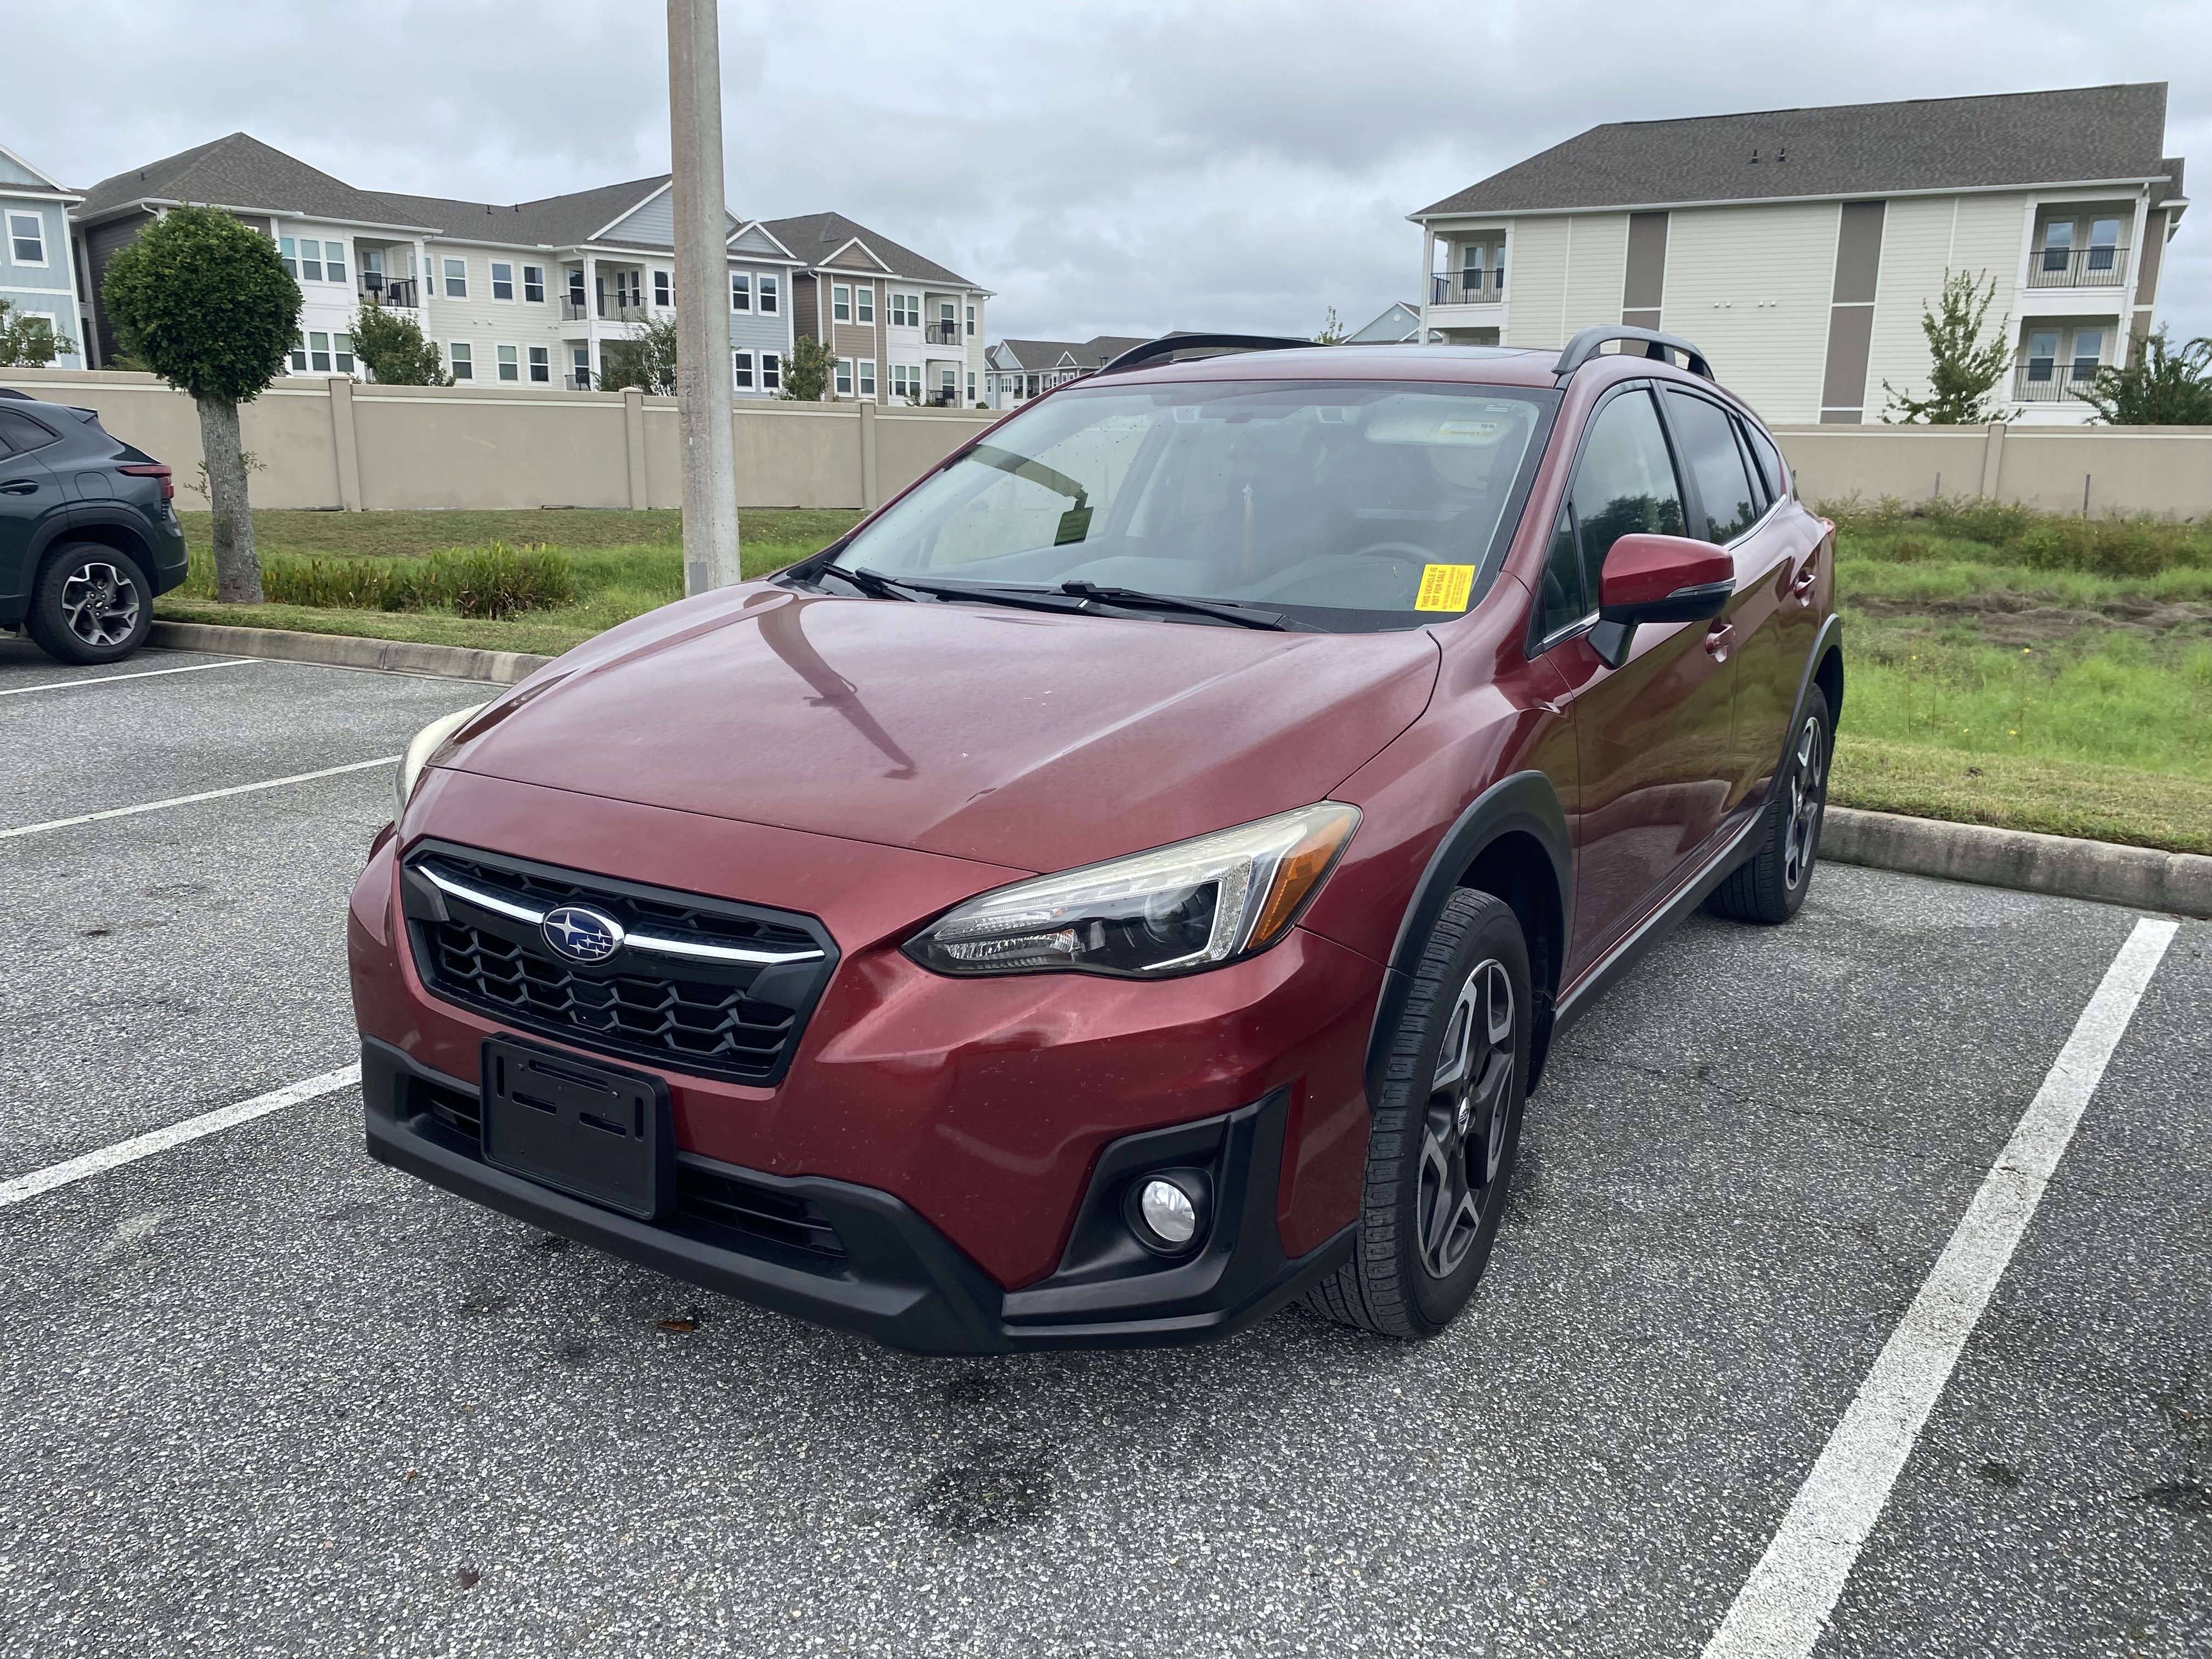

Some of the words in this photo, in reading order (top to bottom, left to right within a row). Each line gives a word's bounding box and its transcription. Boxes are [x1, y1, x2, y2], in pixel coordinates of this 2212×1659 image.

[1436, 570, 1446, 583] SALE
[1424, 573, 1436, 594] VEHICLE
[1434, 584, 1443, 594] FOR
[1421, 595, 1430, 608] THIS
[1431, 595, 1440, 606] NOT
